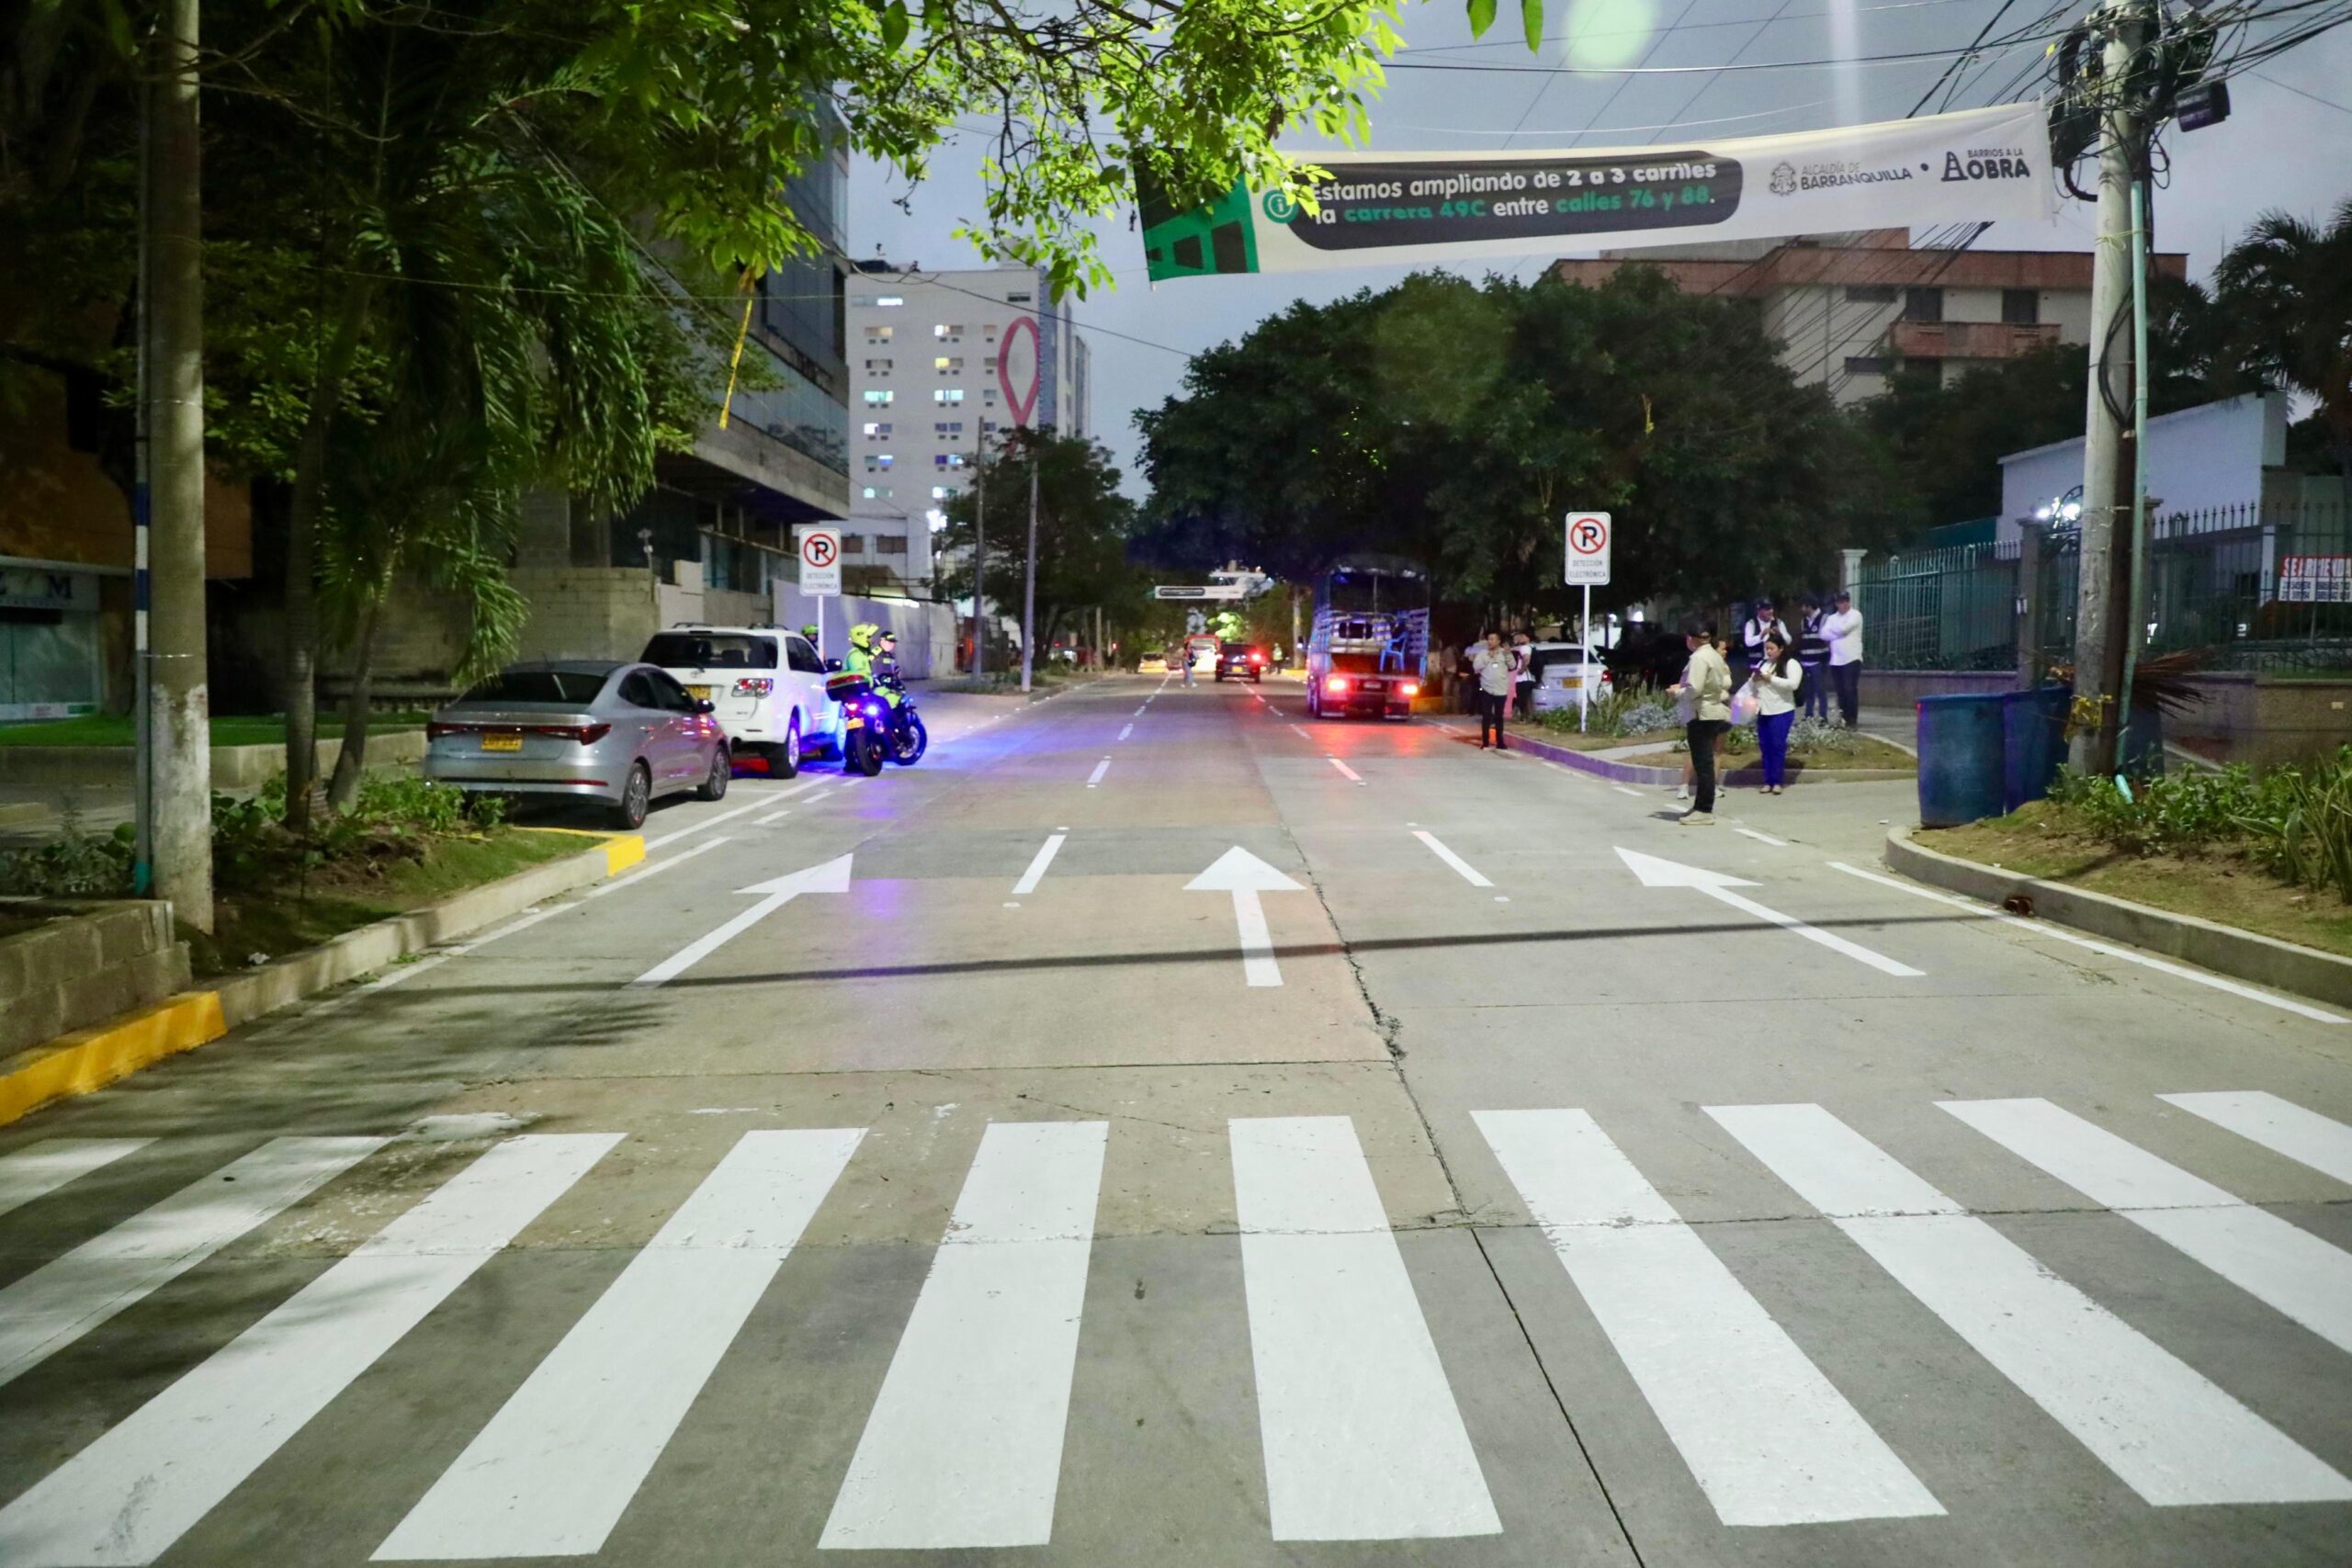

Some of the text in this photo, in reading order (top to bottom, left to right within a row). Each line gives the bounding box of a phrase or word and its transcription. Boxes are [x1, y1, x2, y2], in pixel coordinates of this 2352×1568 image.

[1967, 149, 2004, 158] BARRIOS
[1801, 168, 1913, 190] BARRANQUILLA
[1802, 162, 1860, 175] ALCALDÍA DE
[1967, 158, 2030, 179] OBRA
[1310, 163, 1716, 201] Estamos ampliando de 2 a 3 carriles
[1343, 205, 1433, 222] carrera
[1439, 199, 1487, 219] 49C
[1493, 197, 1550, 217] entre
[1555, 191, 1623, 214] calles
[1629, 188, 1656, 208] 76
[1661, 191, 1674, 211] y
